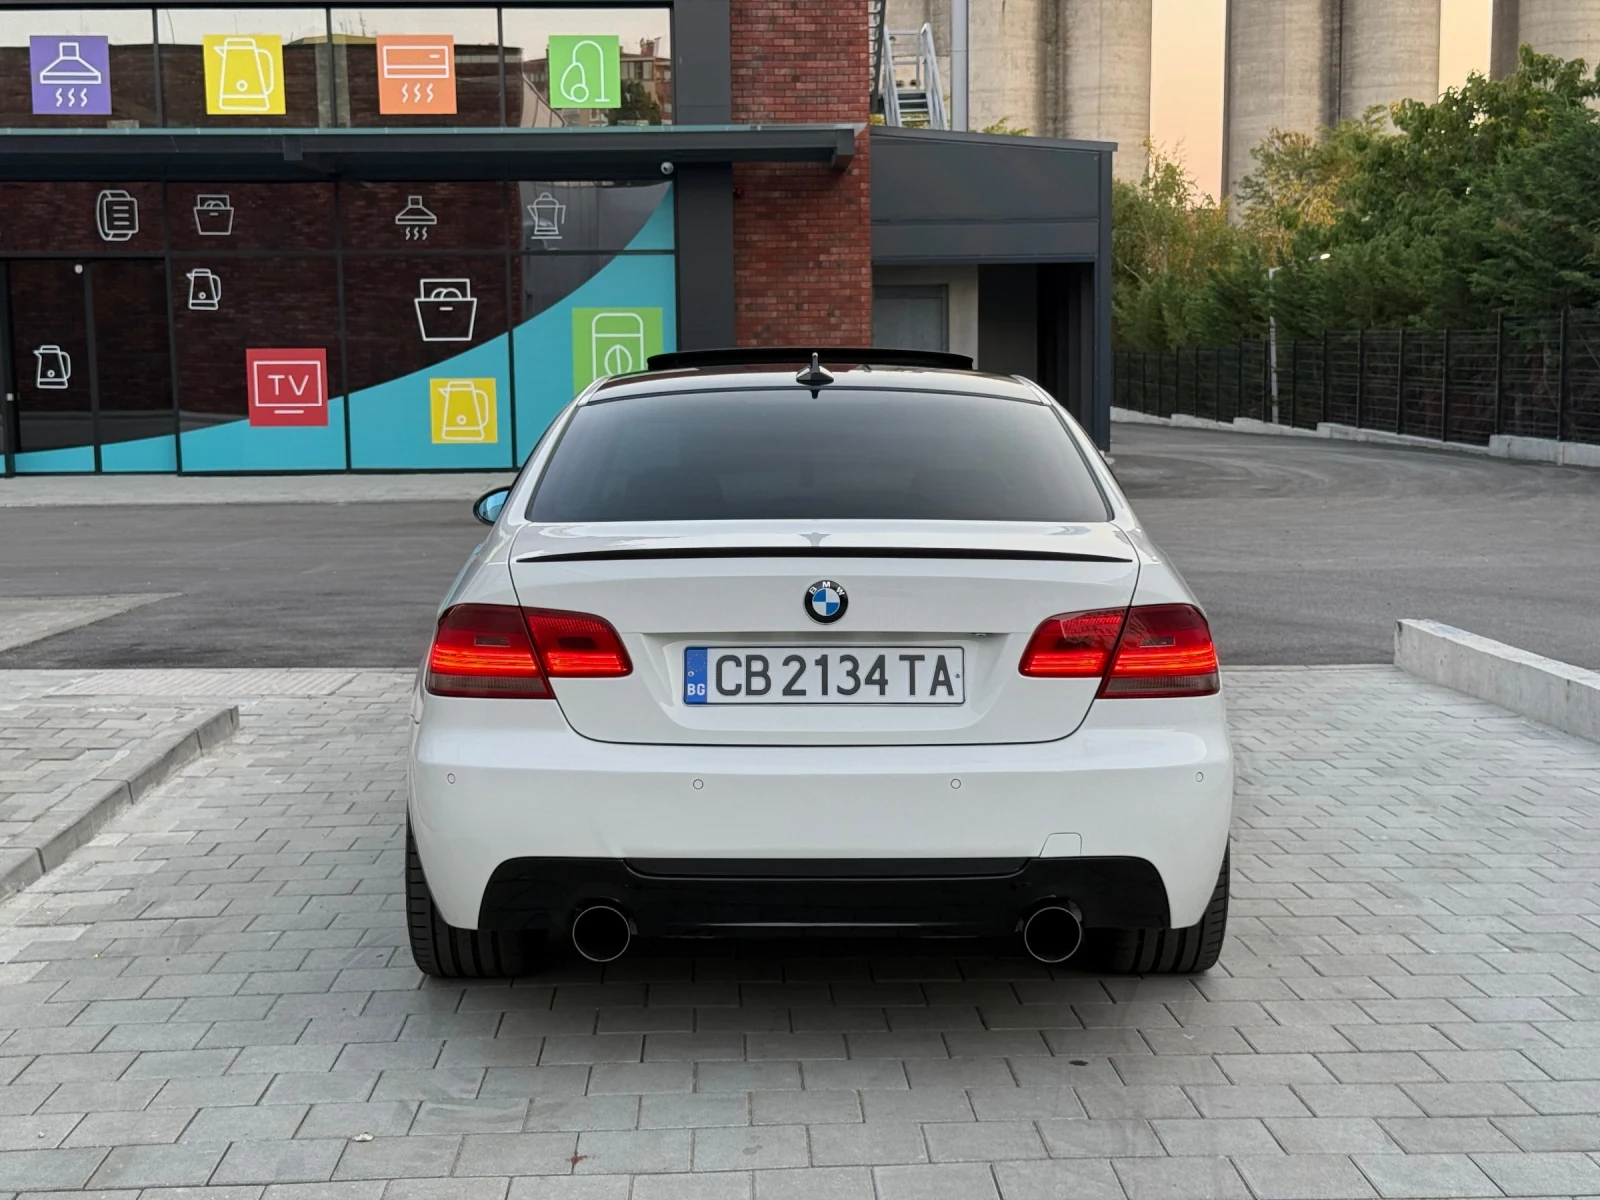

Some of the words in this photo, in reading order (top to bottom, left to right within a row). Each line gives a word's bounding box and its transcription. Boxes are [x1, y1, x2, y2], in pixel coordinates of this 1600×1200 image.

[267, 374, 309, 396] TV
[808, 581, 845, 595] BMW
[687, 683, 706, 696] BG
